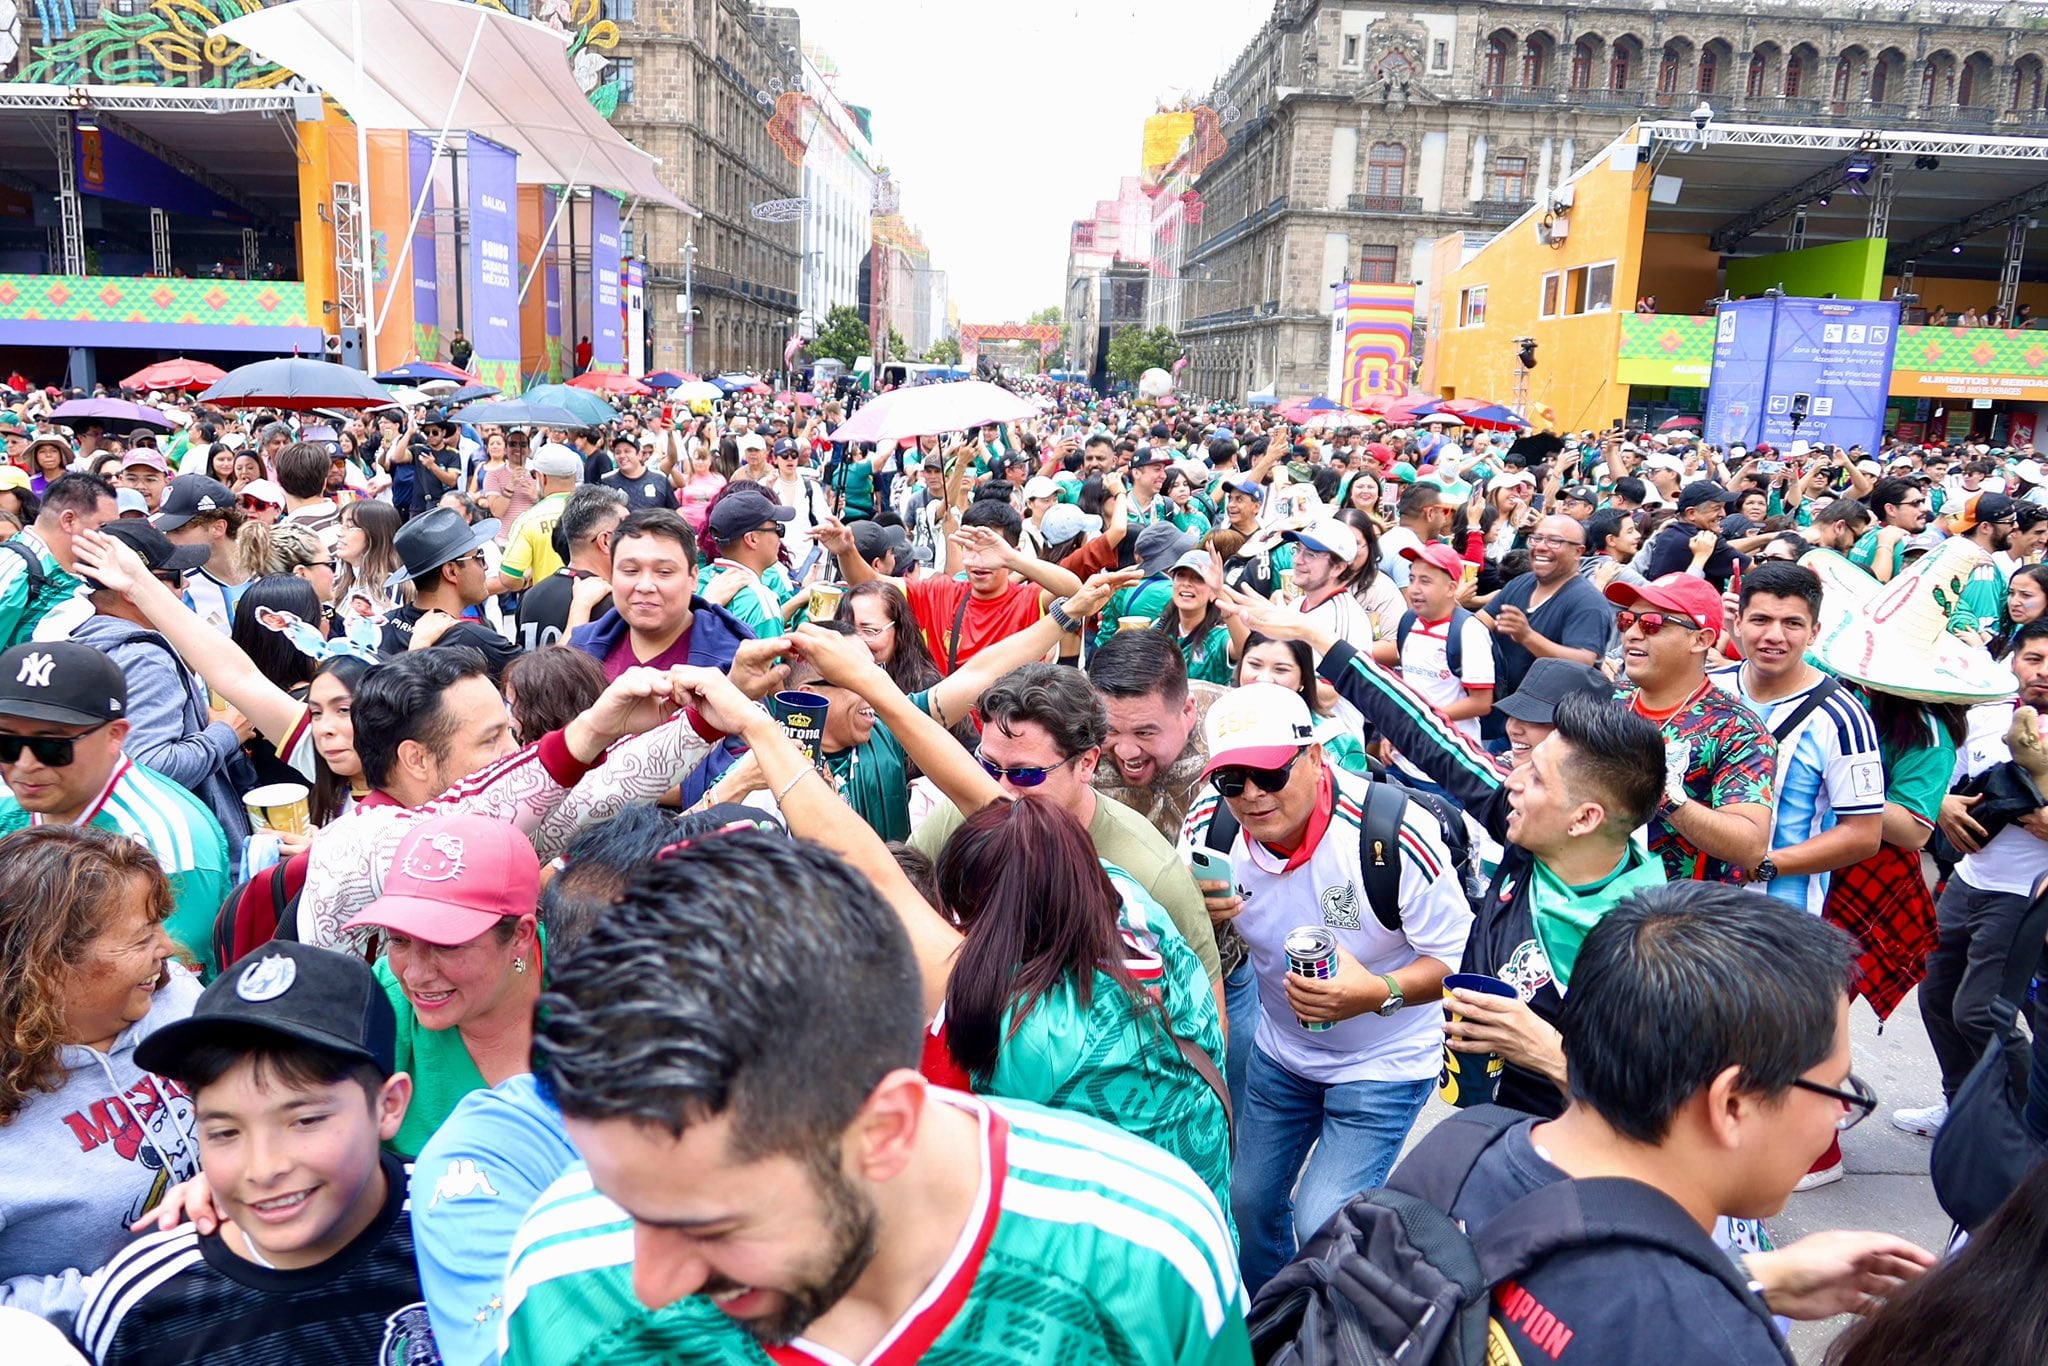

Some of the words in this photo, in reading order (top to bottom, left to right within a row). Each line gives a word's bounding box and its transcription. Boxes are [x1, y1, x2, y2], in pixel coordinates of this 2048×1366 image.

[482, 194, 507, 213] SALIDA
[482, 272, 510, 288] MÉXICO
[1716, 347, 1731, 357] Mapa
[1793, 346, 1810, 354] Zona
[1811, 346, 1820, 354] de
[1821, 347, 1850, 356] Atención
[1852, 348, 1885, 357] Prioritaria
[1846, 357, 1869, 365] Service
[1870, 358, 1885, 366] Area
[1845, 371, 1882, 379] Prioritarios
[1815, 378, 1847, 386] Accessible
[1848, 379, 1881, 387] Restrooms
[1918, 375, 1989, 385] ALIMENTOS
[1991, 377, 2001, 385] Y
[2000, 378, 2048, 387] BEBIDAS
[1947, 385, 1966, 393] FOOD
[1966, 386, 1982, 394] AND
[1982, 386, 2022, 395] BEVERAGES
[1813, 420, 1829, 429] City
[1781, 428, 1793, 436] City
[1795, 429, 1820, 437] Campus
[16, 652, 57, 687] NY
